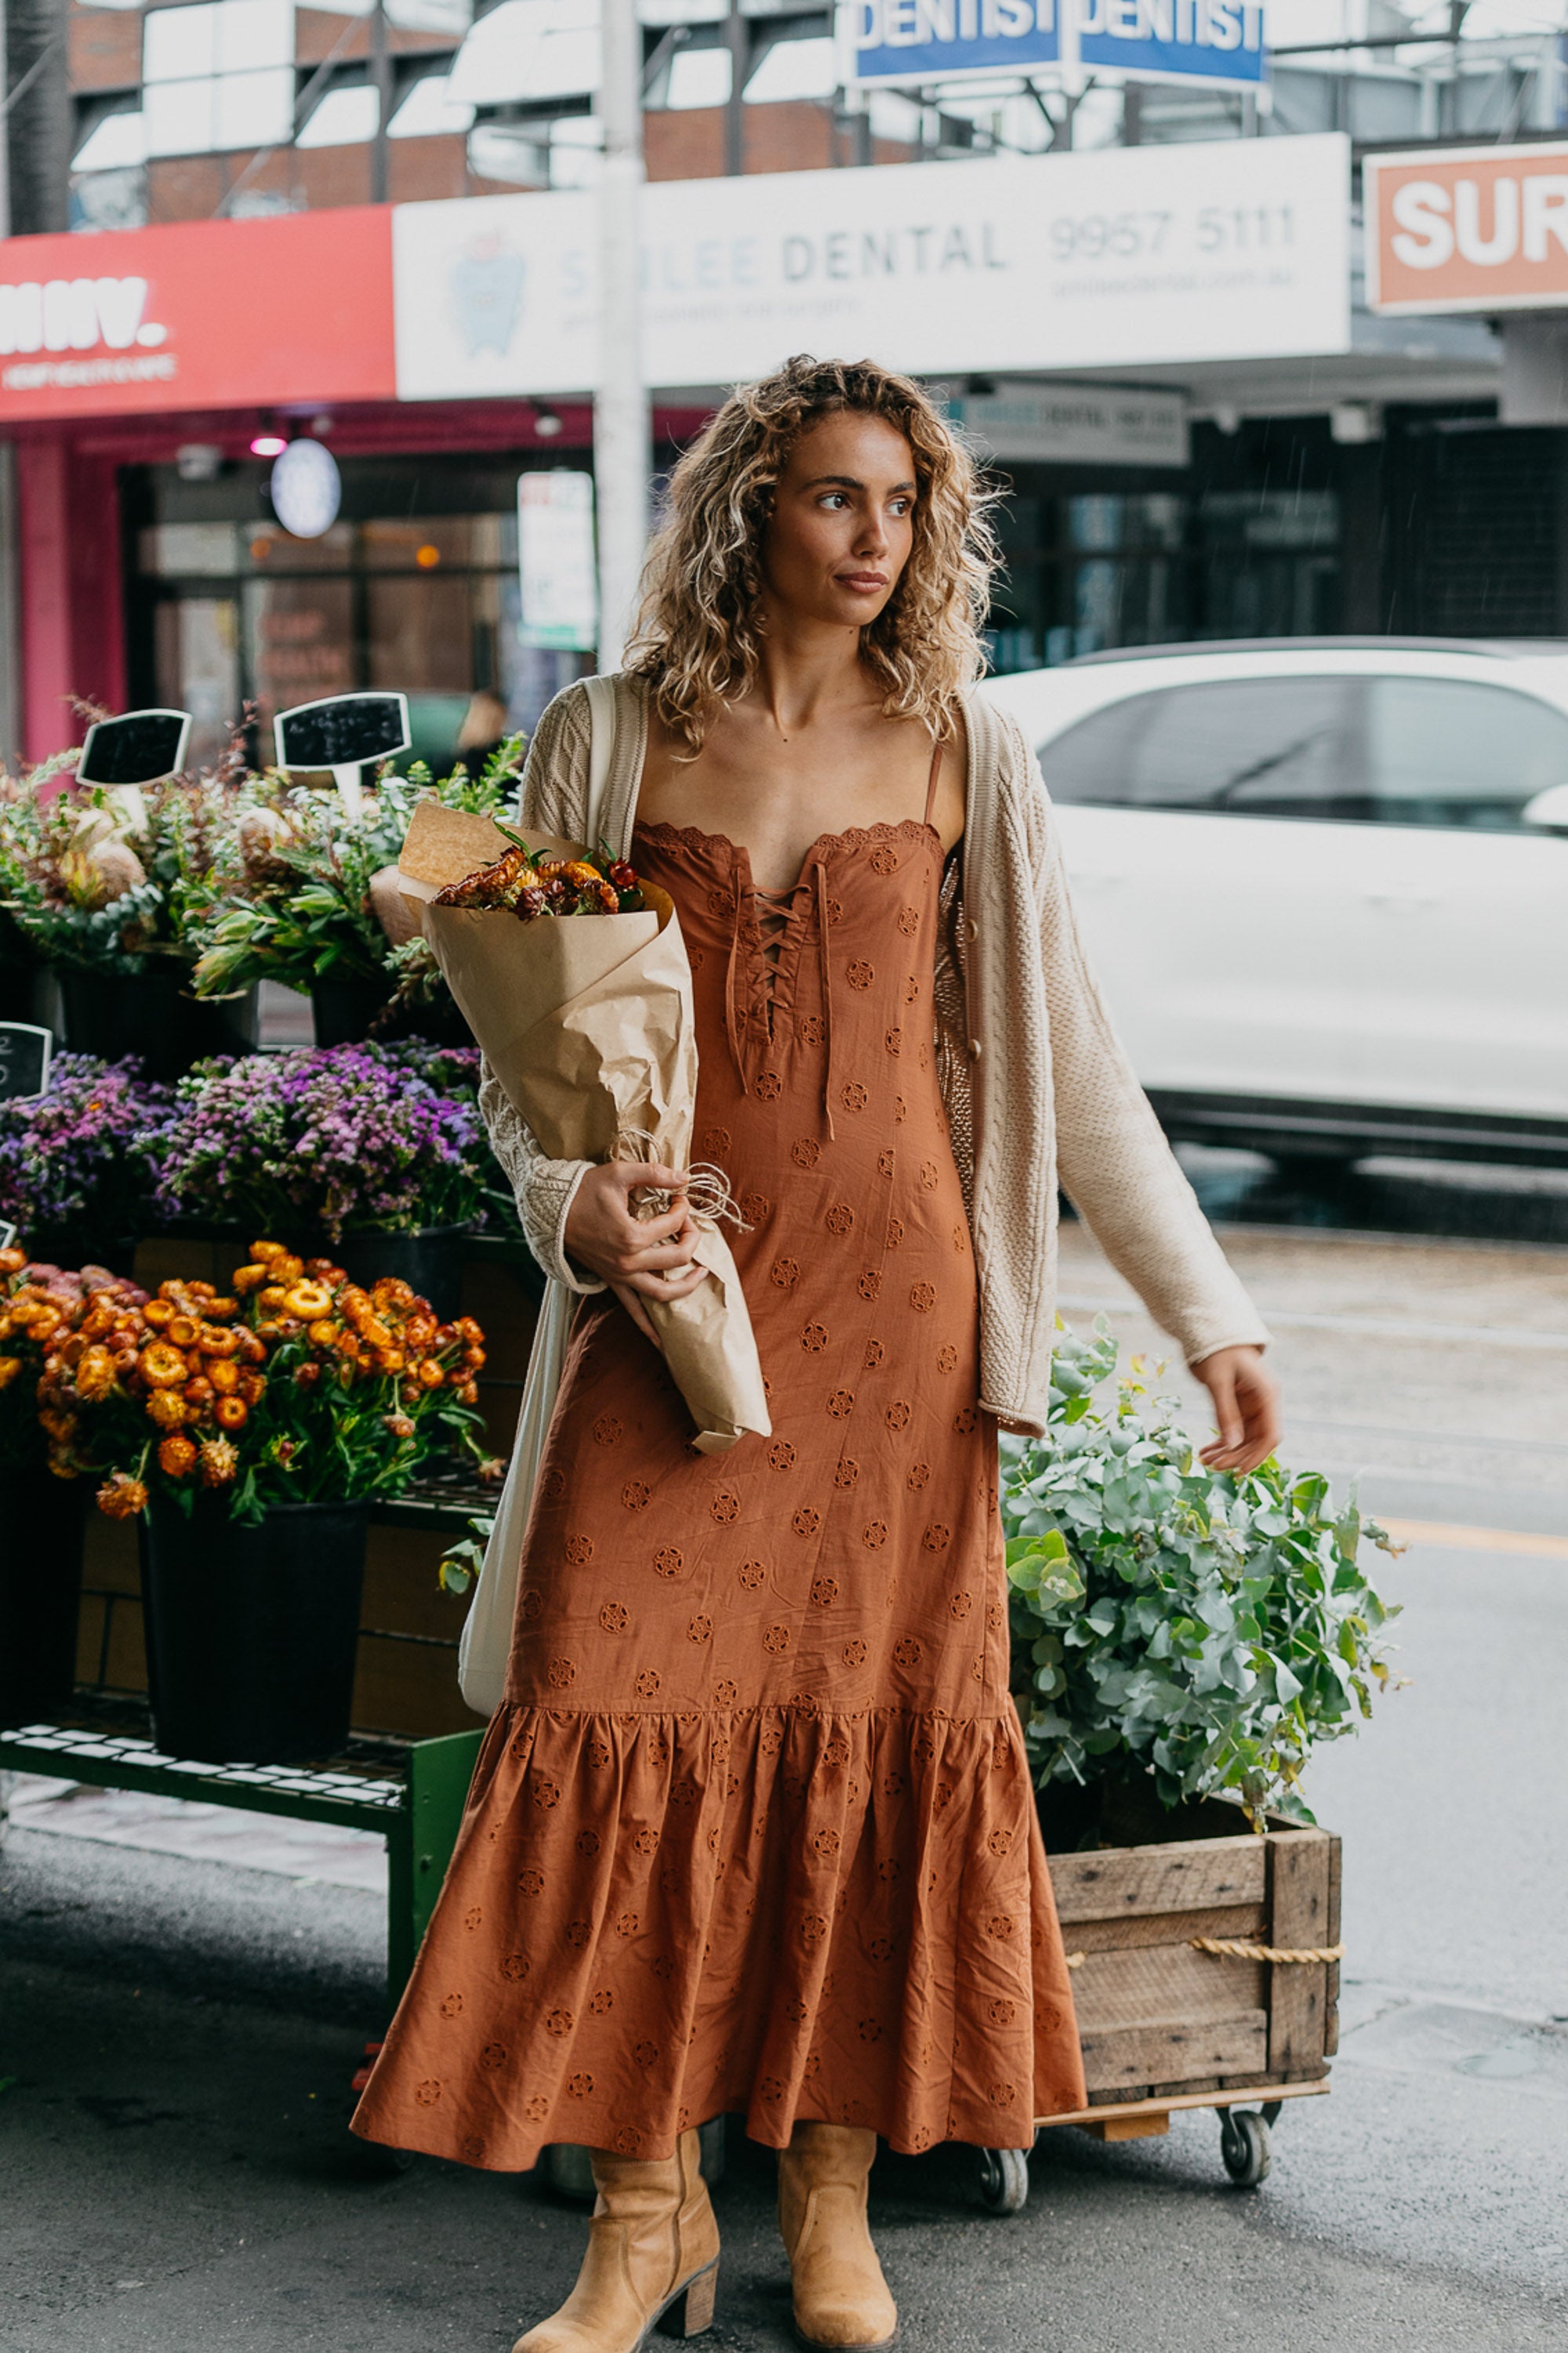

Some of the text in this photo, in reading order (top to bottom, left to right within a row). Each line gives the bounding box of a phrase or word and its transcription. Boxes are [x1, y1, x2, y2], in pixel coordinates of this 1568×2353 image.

[858, 0, 1054, 49] DENTIST
[1080, 0, 1262, 52] DENTIST
[1196, 203, 1295, 253] 5111
[1391, 173, 1568, 269] SUR
[559, 220, 1008, 298] SILEE DENTAL
